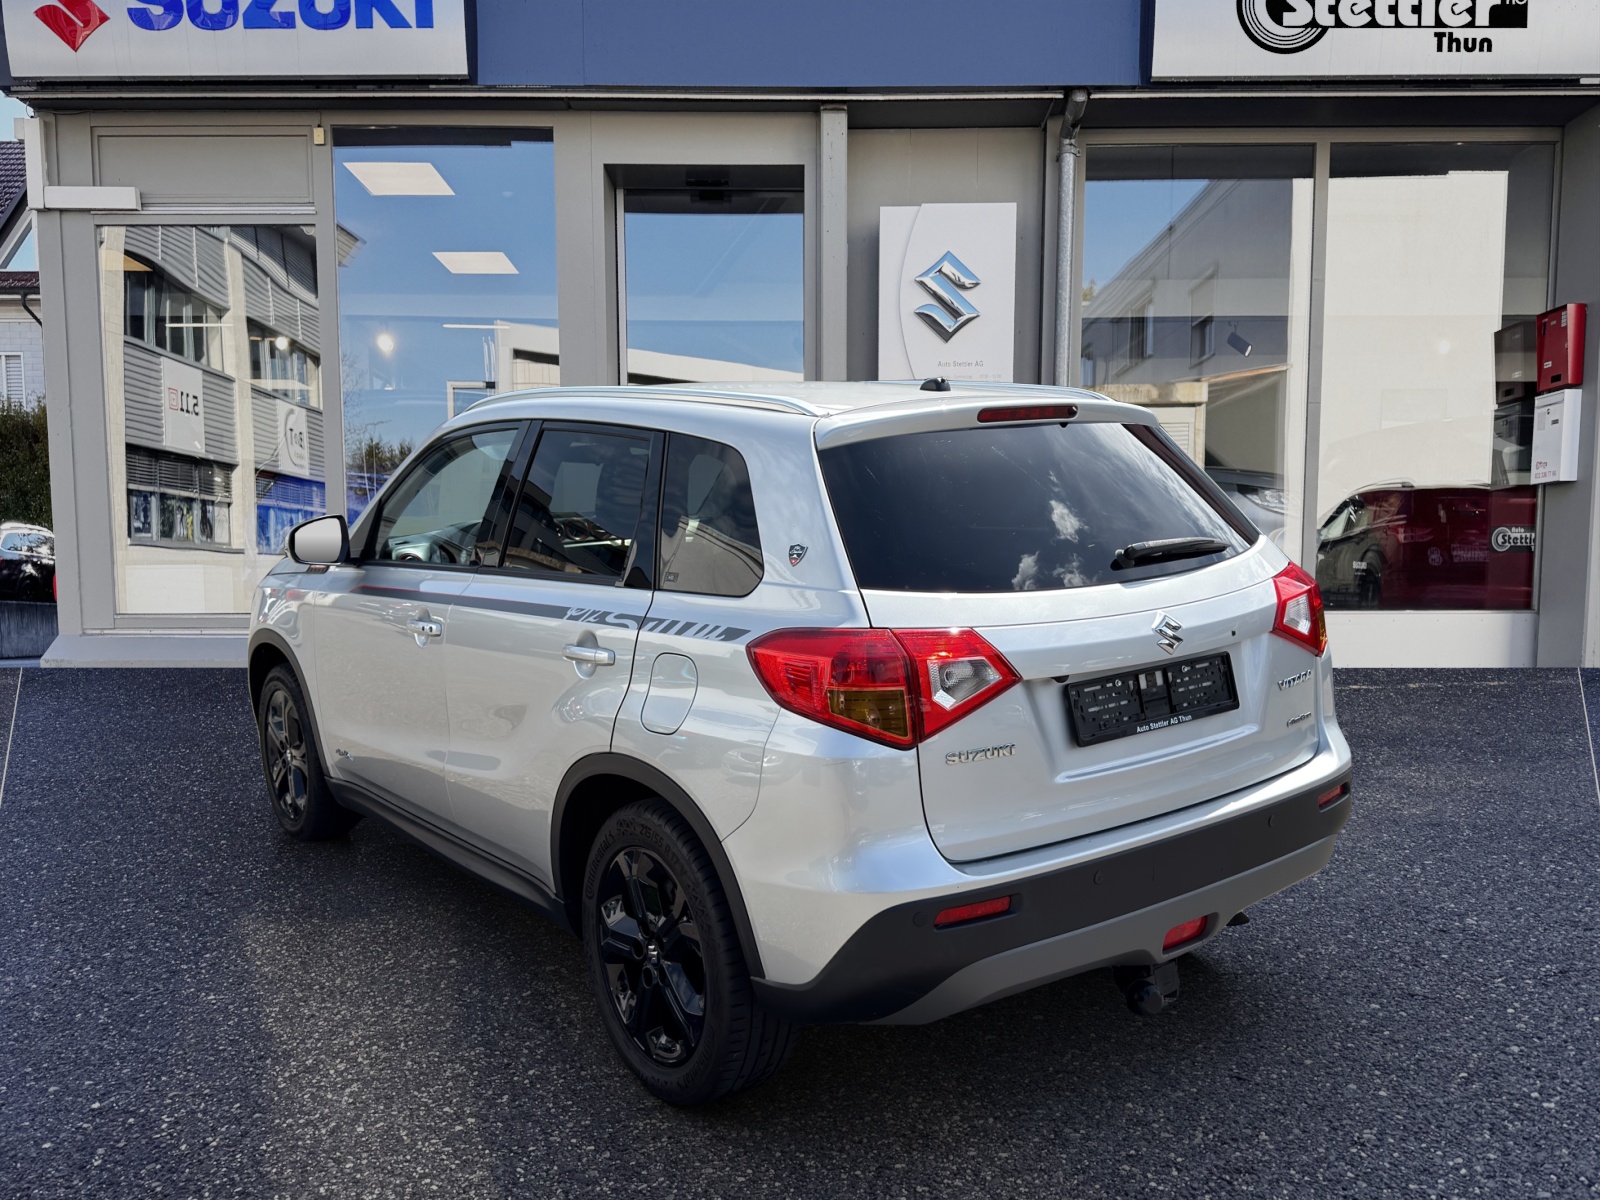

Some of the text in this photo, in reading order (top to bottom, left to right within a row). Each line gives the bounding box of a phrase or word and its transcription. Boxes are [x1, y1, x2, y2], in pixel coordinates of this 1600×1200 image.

[127, 0, 434, 30] SUZUKI
[1434, 31, 1493, 53] Thun
[937, 360, 984, 368] Auto Stettler AG
[1277, 669, 1312, 691] VITARA
[1136, 714, 1193, 733] Auto Stettler AG Thun
[945, 742, 1016, 766] SUZUKI
